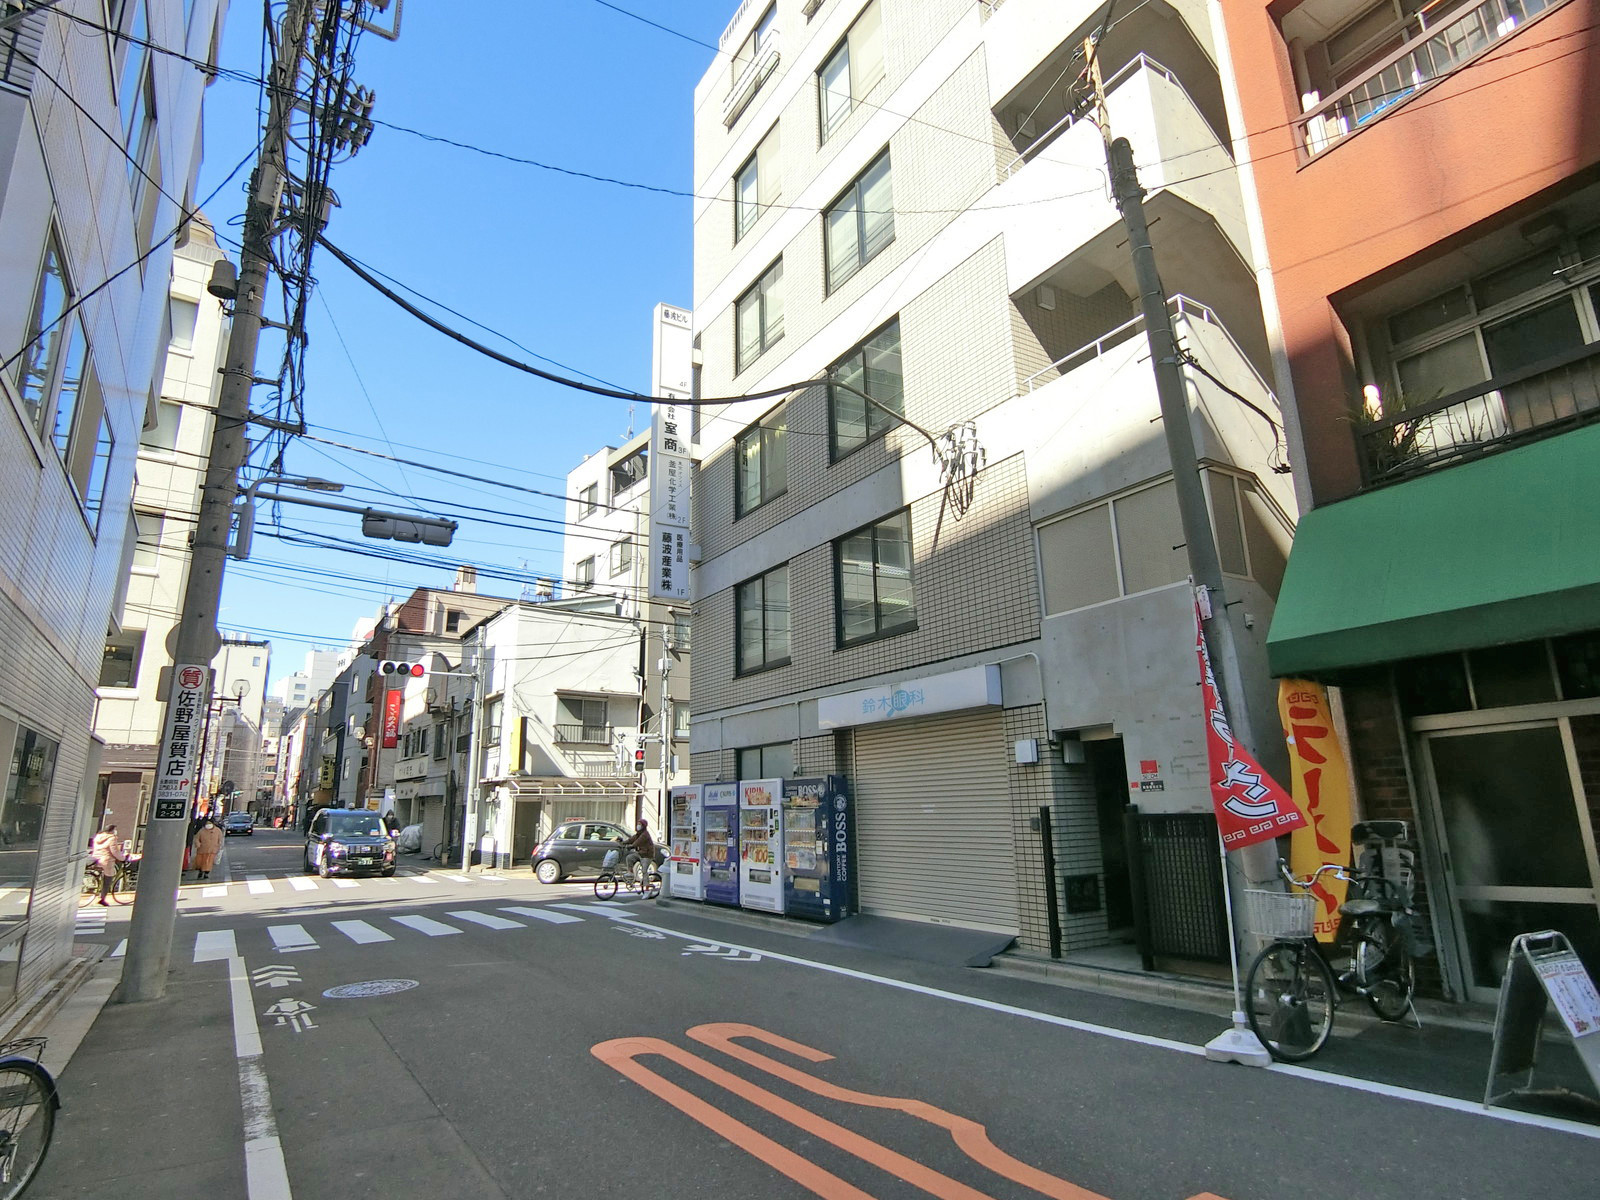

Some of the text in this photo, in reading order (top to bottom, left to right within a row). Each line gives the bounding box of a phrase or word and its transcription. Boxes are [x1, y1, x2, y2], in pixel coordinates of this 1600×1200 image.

[664, 309, 688, 323] 藤波ビル
[677, 516, 686, 524] 2F
[676, 533, 684, 563] 医療用品
[677, 588, 685, 596] 1F
[180, 668, 202, 688] 質
[862, 688, 925, 714] 鈴木眼科
[166, 690, 196, 776] 佐野屋質店
[160, 810, 181, 818] 2-24
[835, 812, 847, 853] BOSS
